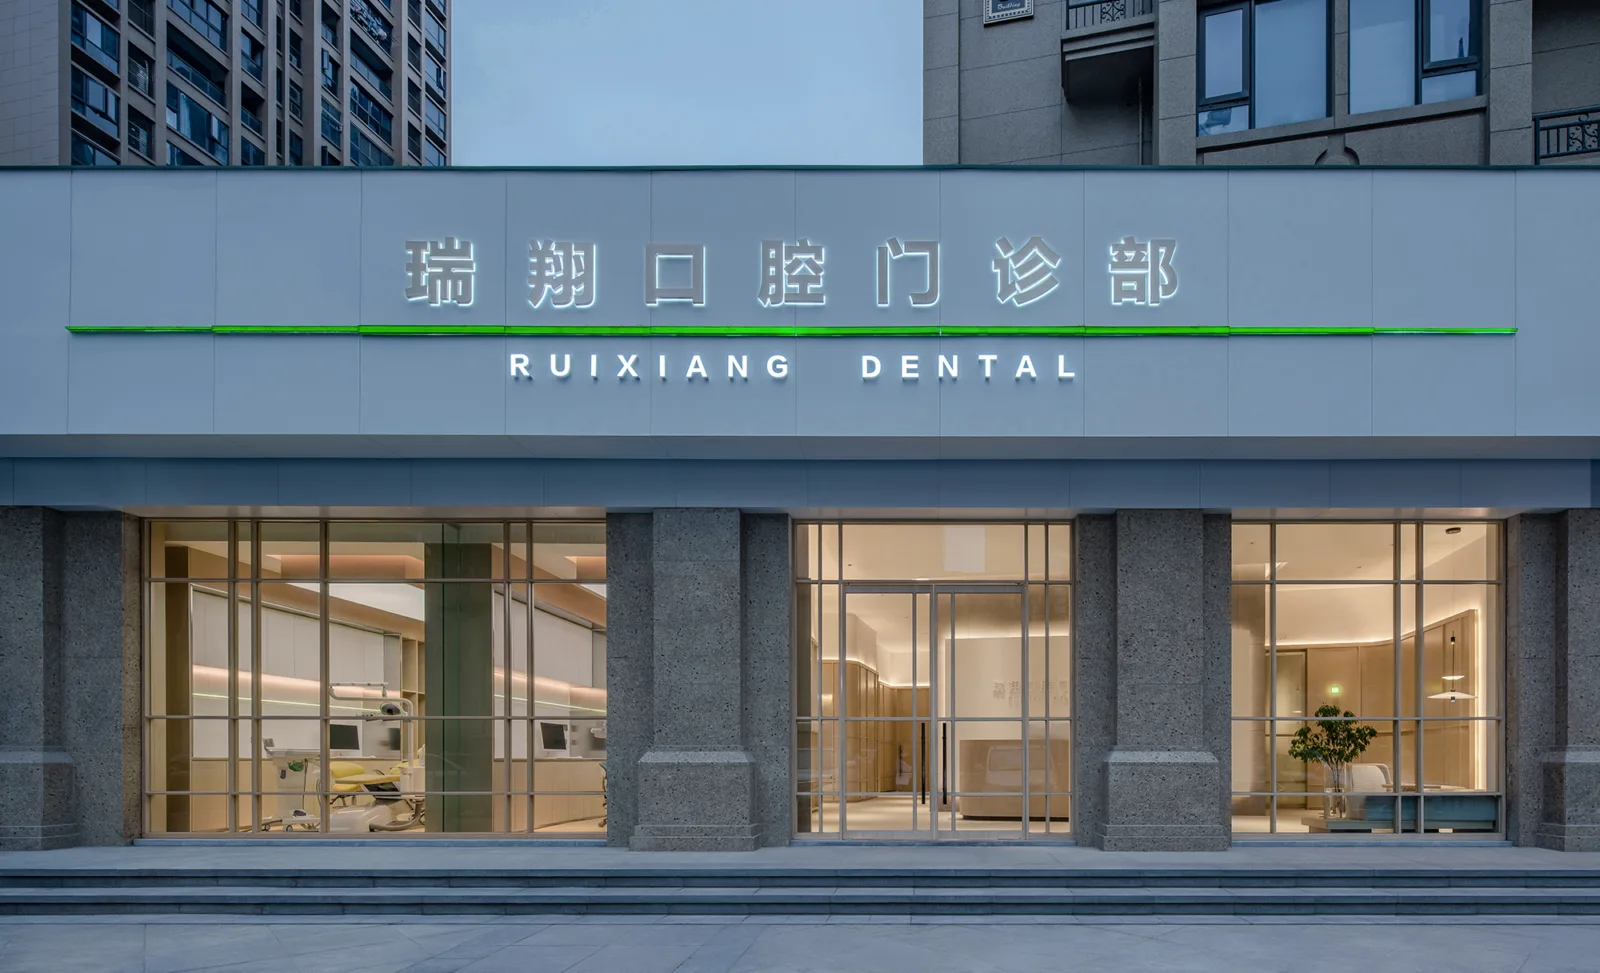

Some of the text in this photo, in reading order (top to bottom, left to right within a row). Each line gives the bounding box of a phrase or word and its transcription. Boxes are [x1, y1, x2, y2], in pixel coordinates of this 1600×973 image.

[405, 236, 1178, 308] 瑞翔口腔门诊部
[509, 353, 1076, 380] RUIXIANG DENTAL
